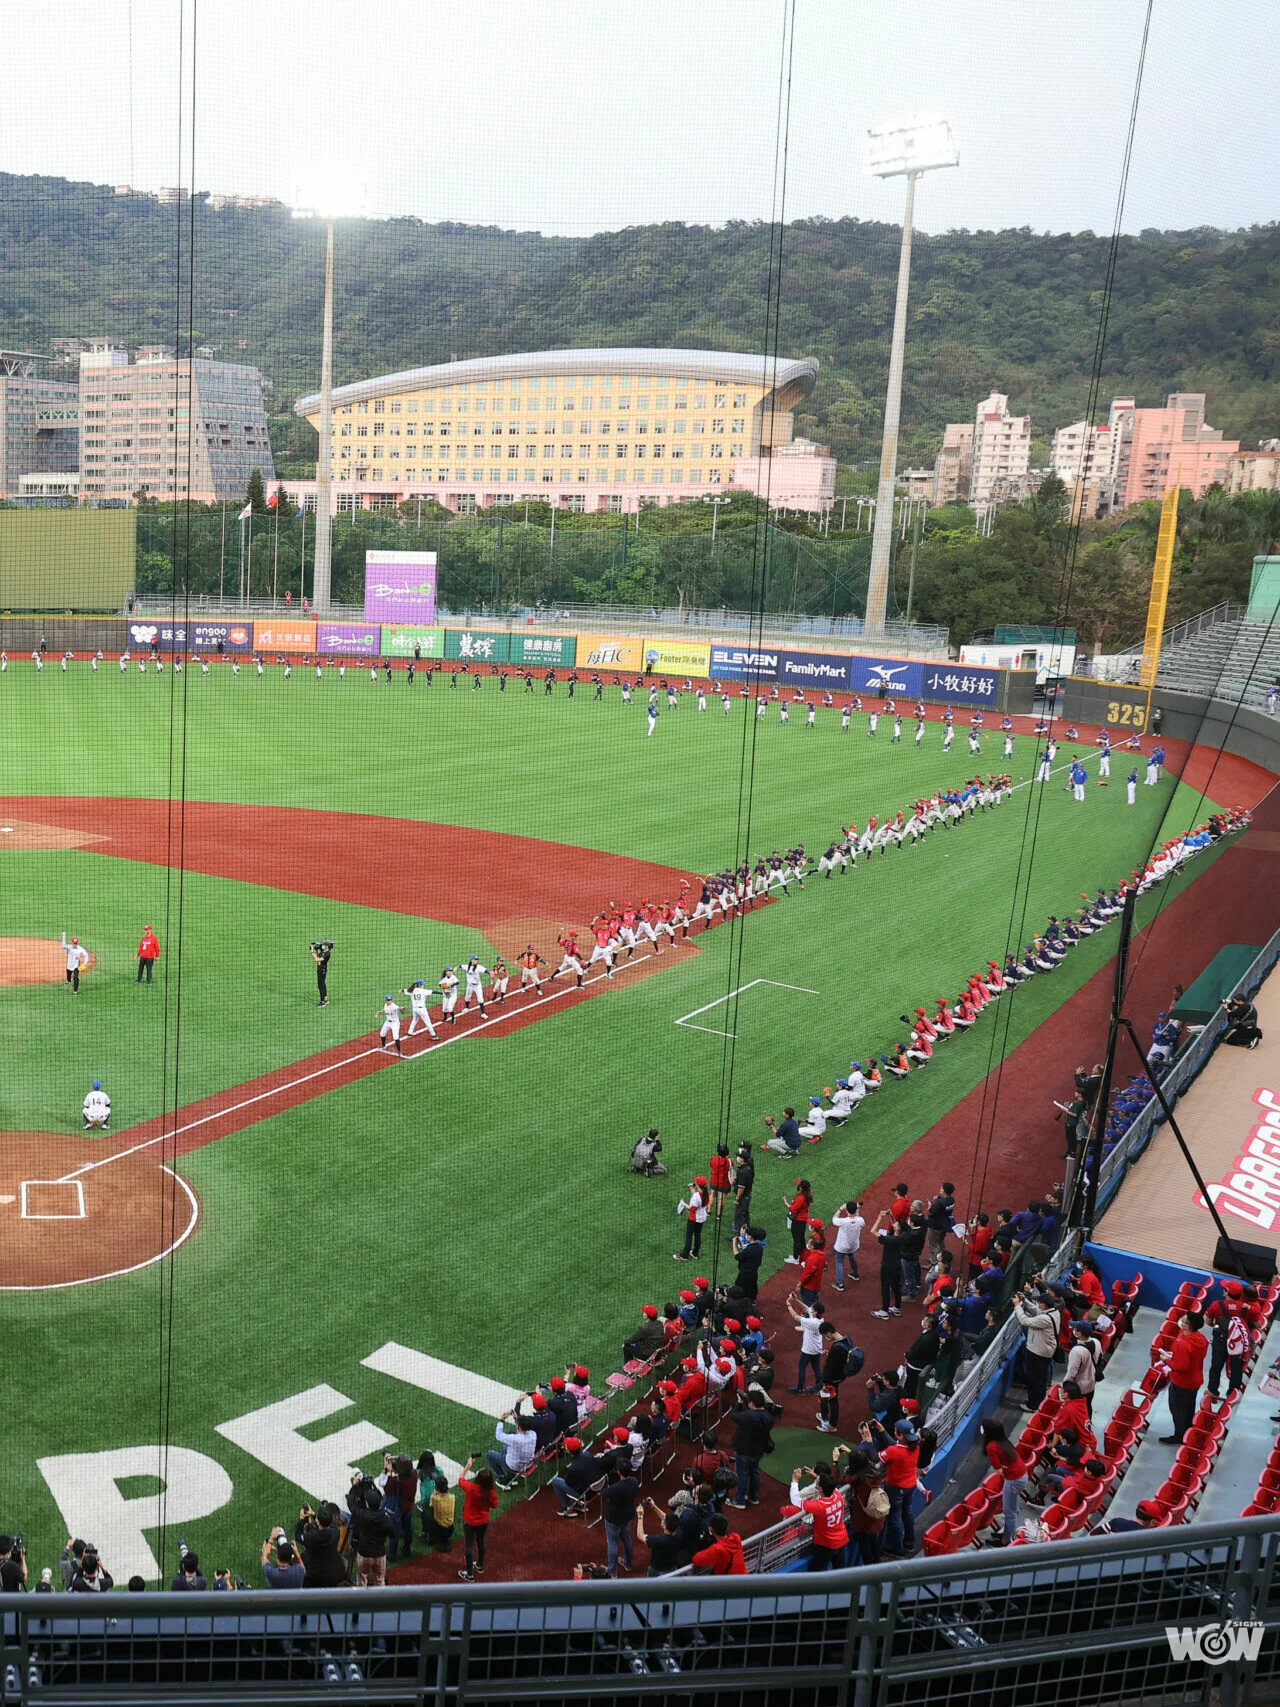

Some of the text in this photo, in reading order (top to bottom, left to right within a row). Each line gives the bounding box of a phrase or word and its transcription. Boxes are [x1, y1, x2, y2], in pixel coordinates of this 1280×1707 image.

[161, 629, 187, 641] 味全
[195, 627, 227, 636] engoo
[713, 651, 778, 667] ELEVEN
[785, 661, 846, 678] FamilyMart
[927, 673, 995, 696] 小牧好好
[1107, 702, 1146, 727] 325
[827, 1510, 842, 1528] 27
